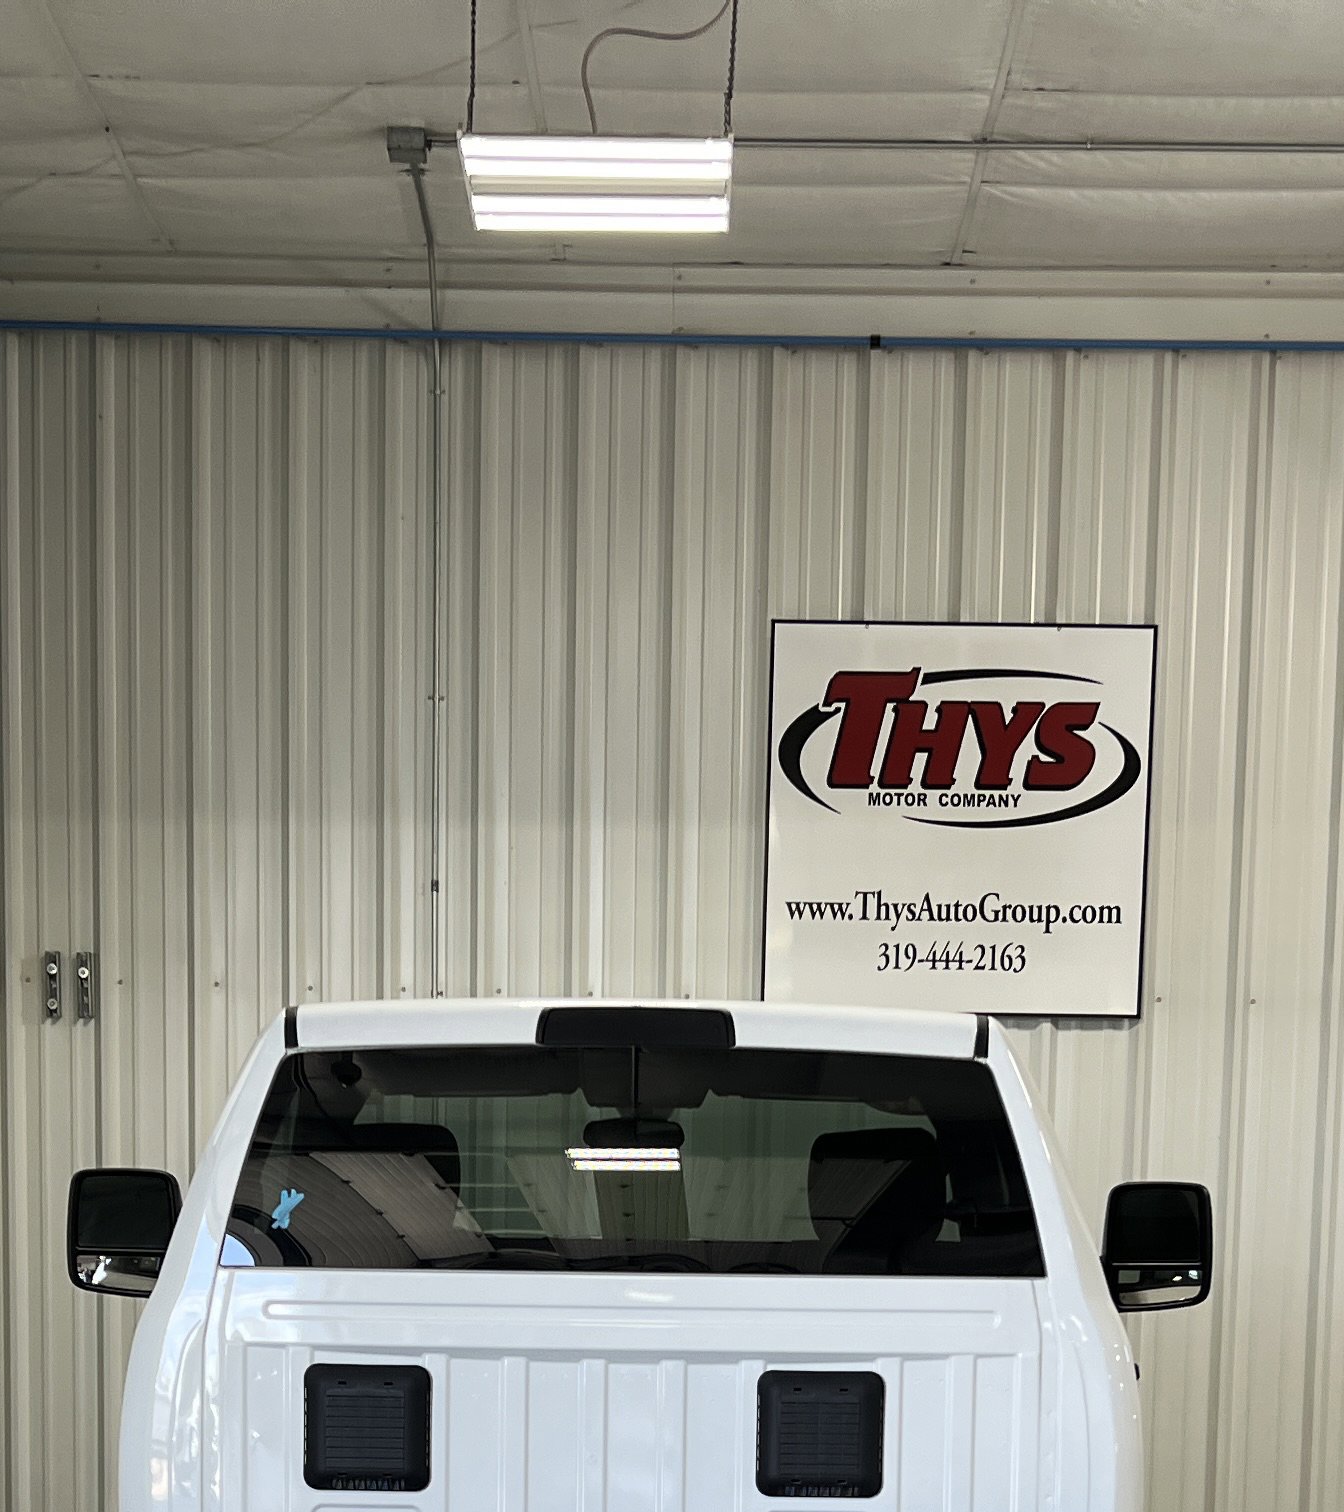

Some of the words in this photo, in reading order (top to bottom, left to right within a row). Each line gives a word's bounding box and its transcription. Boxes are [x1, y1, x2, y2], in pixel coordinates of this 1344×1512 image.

[821, 667, 1101, 792] THYS
[868, 792, 928, 808] MOTOR
[939, 793, 1022, 809] COMPANY
[786, 890, 1122, 934] www.ThysAutoGroup.com
[877, 941, 1026, 973] 319-444-2163
